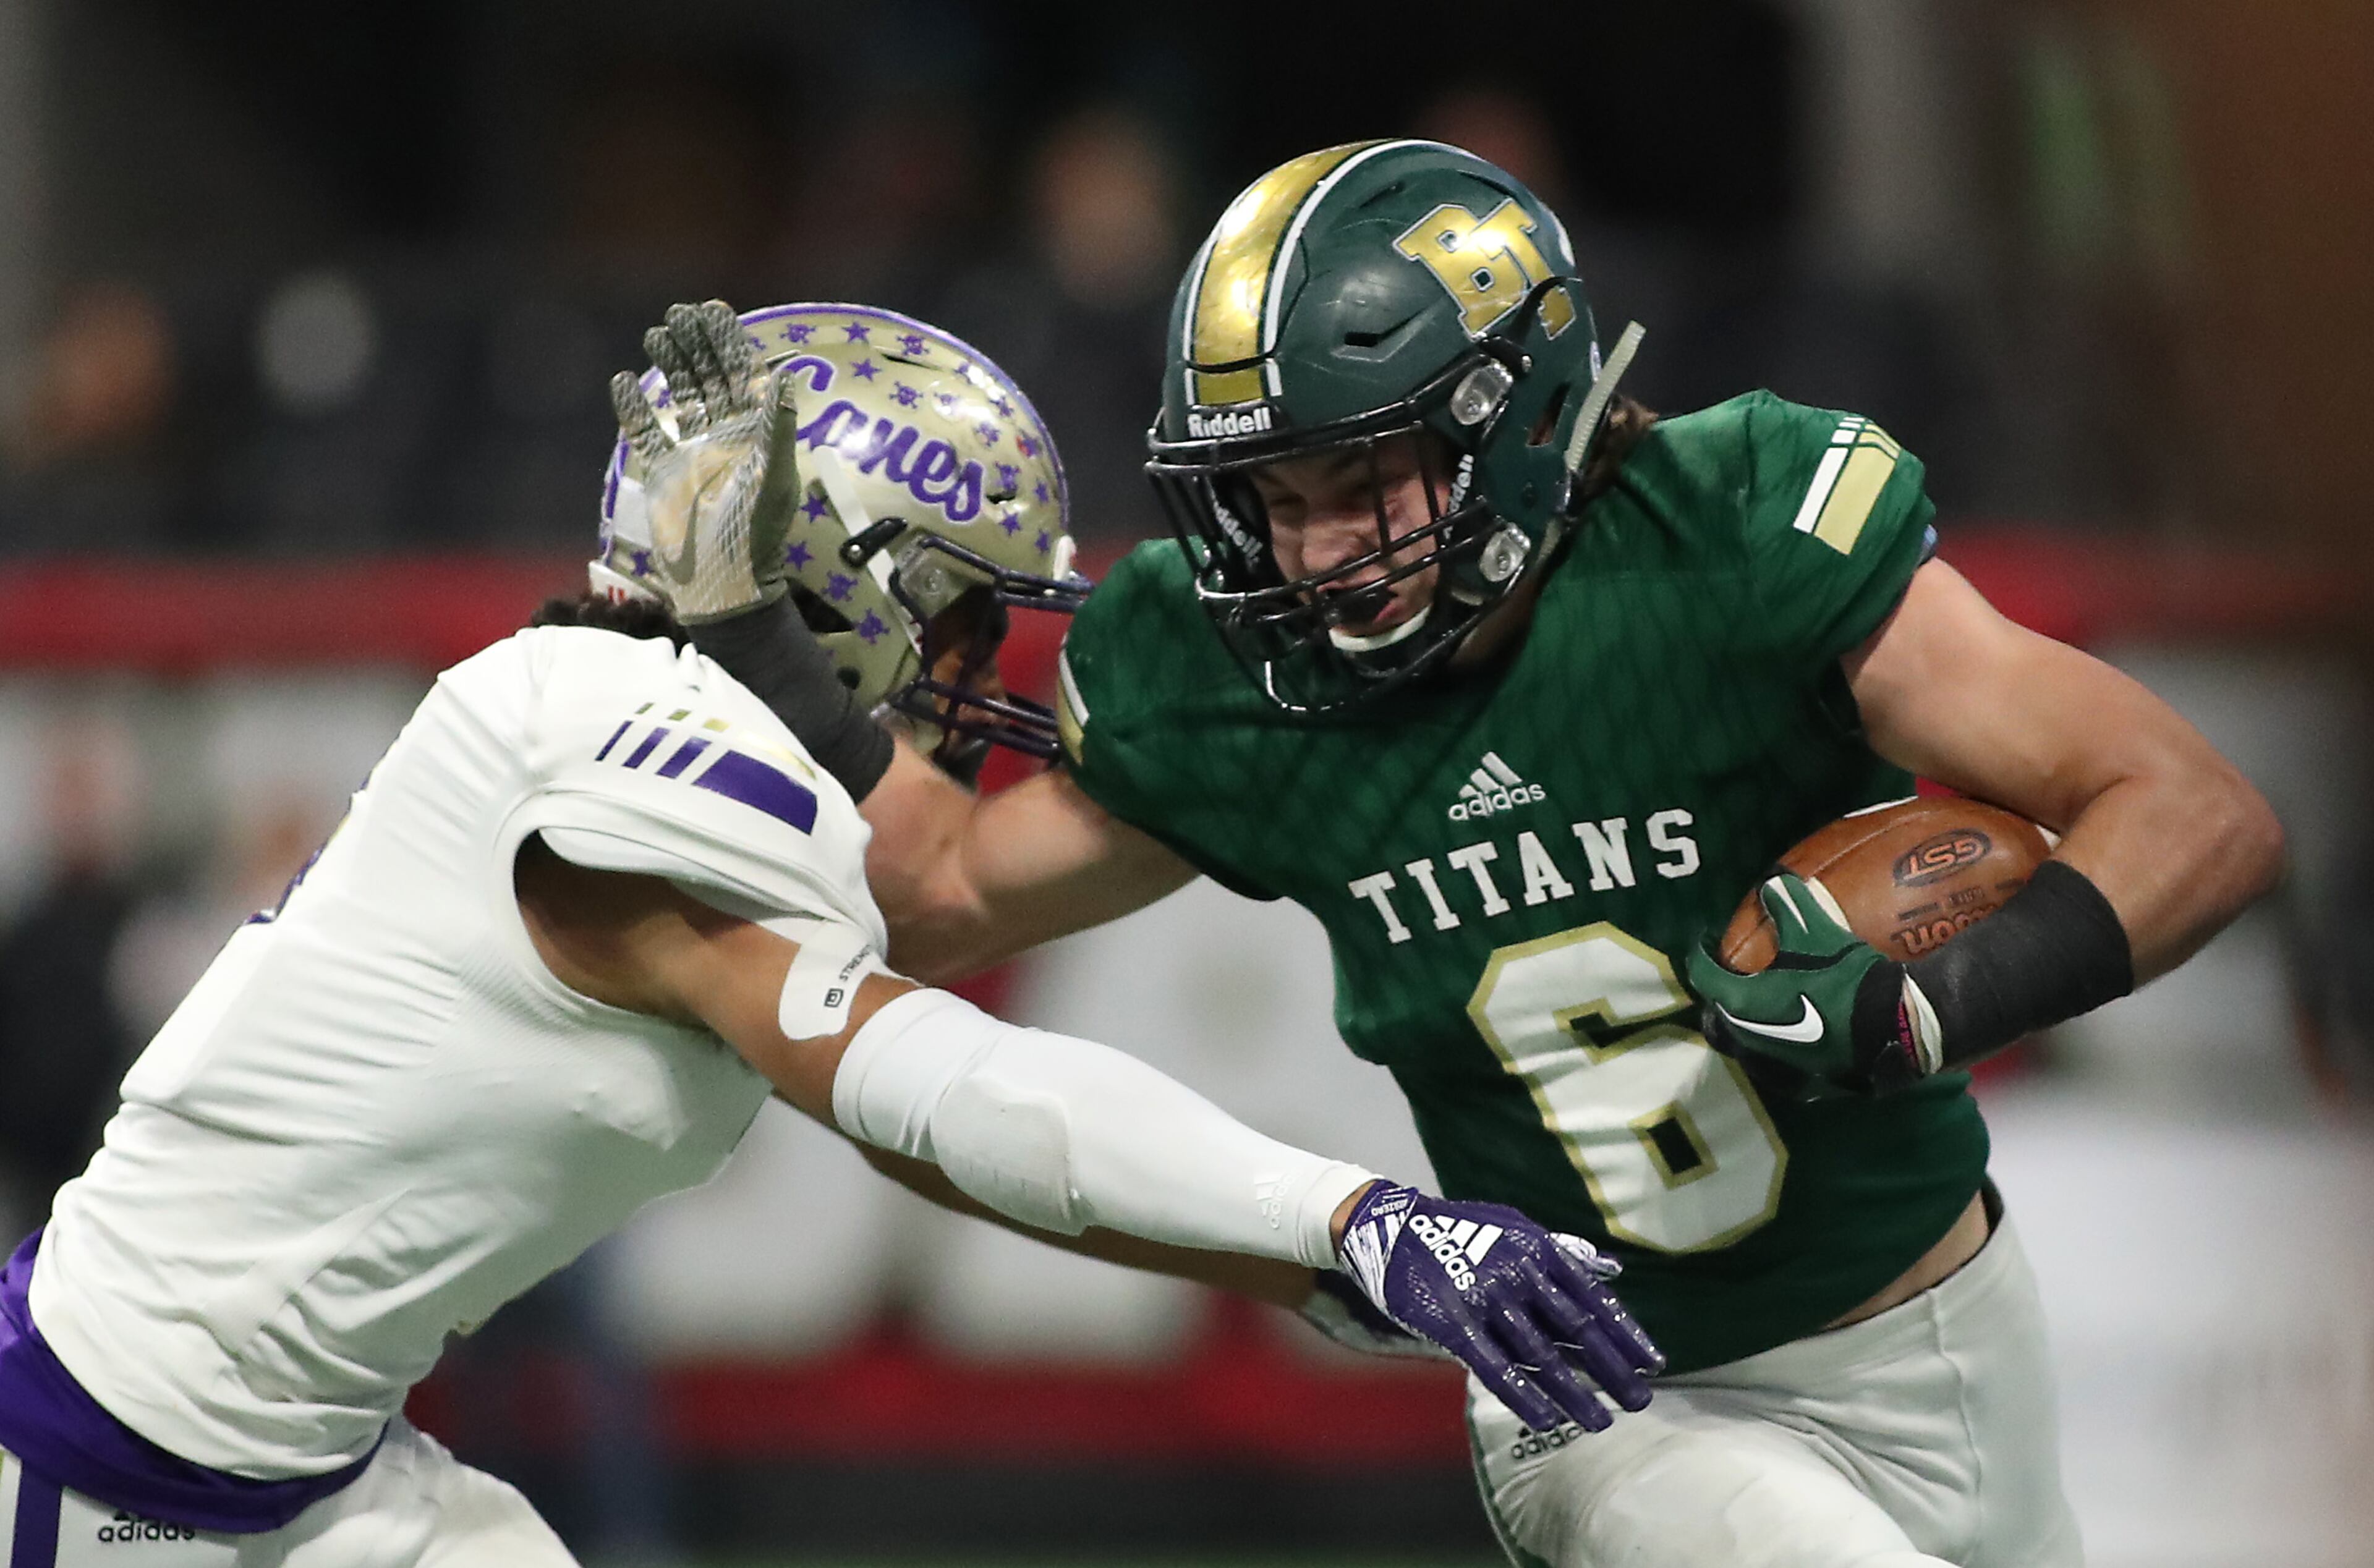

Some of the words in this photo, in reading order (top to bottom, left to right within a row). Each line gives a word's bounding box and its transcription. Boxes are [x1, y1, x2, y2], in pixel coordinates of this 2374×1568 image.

[1187, 407, 1272, 438] Riddell
[1448, 784, 1546, 821] adidas
[1348, 808, 1700, 944] TITANS
[1466, 921, 1789, 1255] 6
[1409, 1214, 1476, 1291] adidas
[1511, 1426, 1586, 1459] adida
